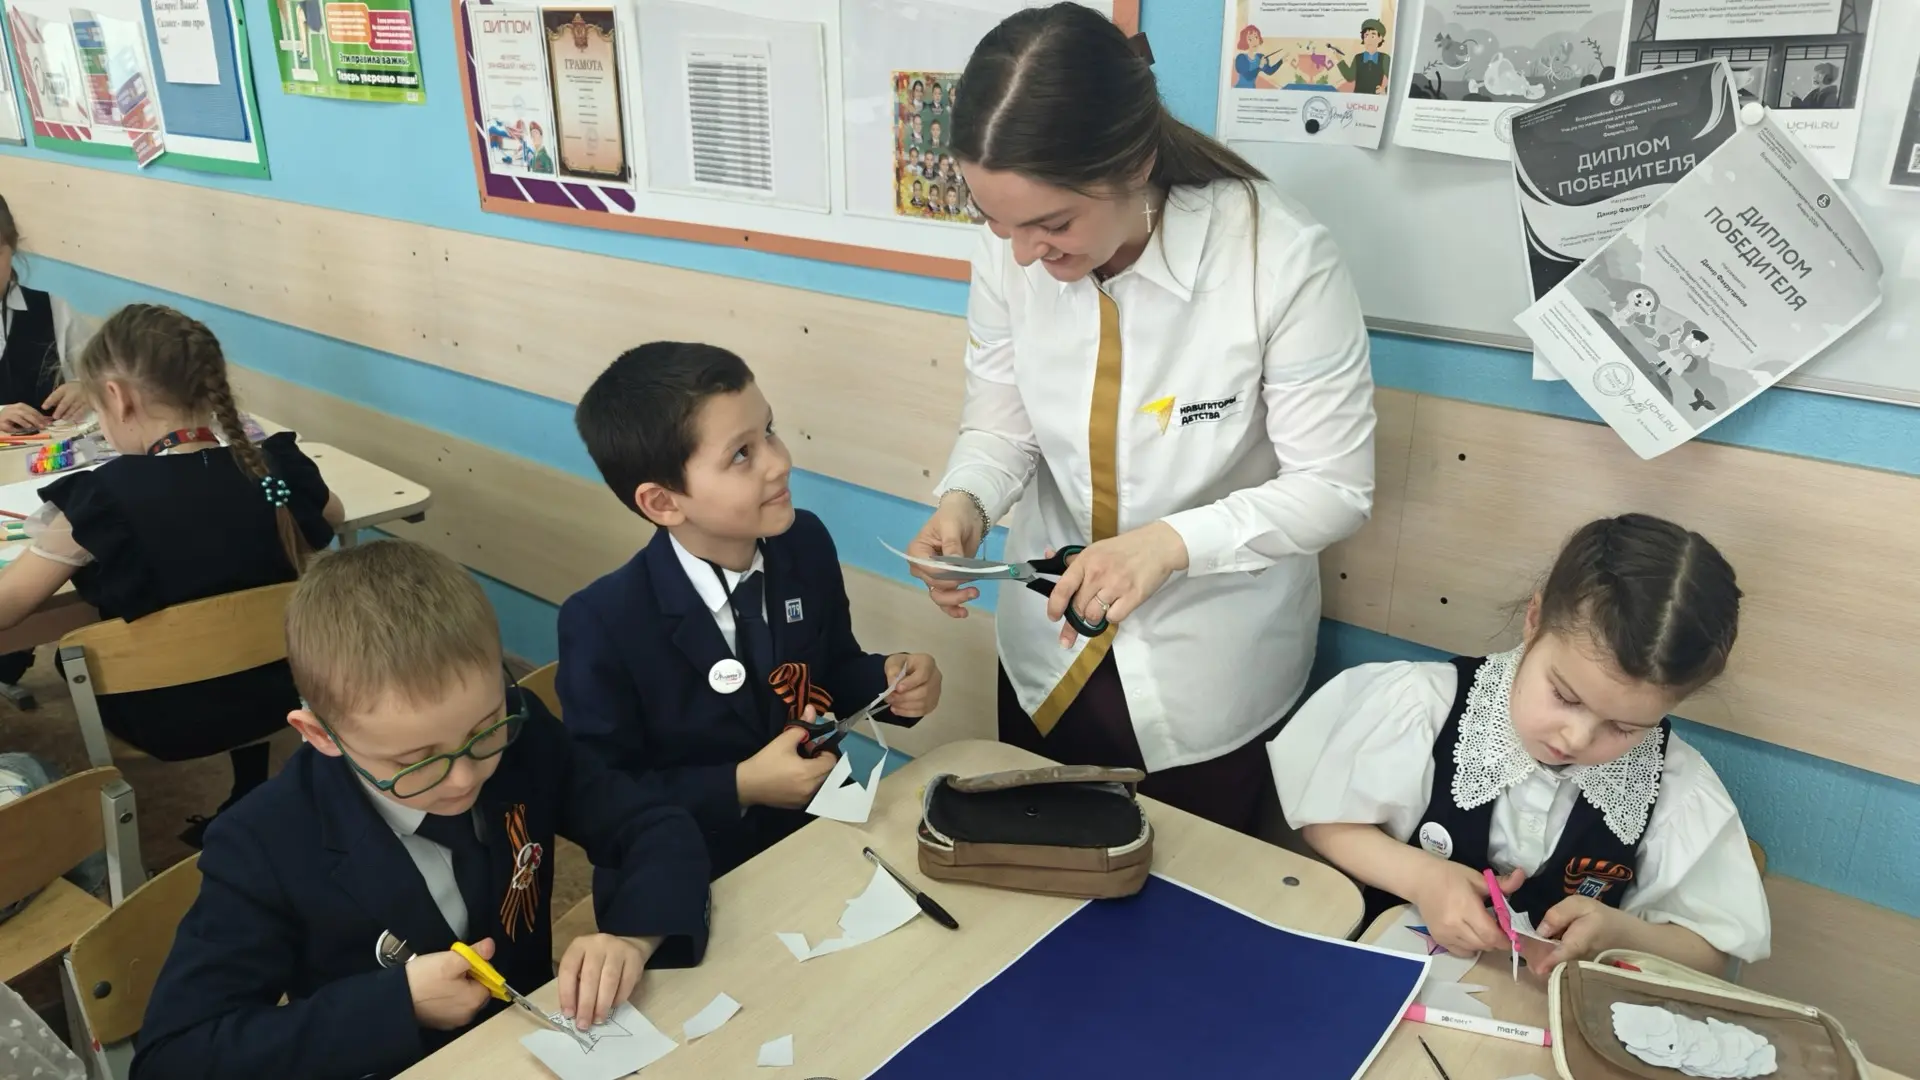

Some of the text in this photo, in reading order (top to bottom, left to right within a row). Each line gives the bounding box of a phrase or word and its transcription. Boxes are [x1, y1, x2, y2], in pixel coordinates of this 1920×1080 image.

[483, 20, 533, 34] ДИПЛОМ
[351, 55, 380, 65] правила
[564, 58, 604, 71] ГРАМОТА
[337, 70, 418, 84] Теперь уверенно пиши!
[1577, 136, 1670, 173] ДИПЛОМ
[1558, 153, 1696, 196] ПОБЕДИТЕЛЯ
[1736, 206, 1812, 279] ДИПЛОМ
[1704, 206, 1807, 311] ПОБЕДИТЕЛЯ
[1180, 396, 1236, 414] НАВИГАТОРЫ
[1181, 411, 1220, 425] ДЕТСТВА
[1581, 881, 1601, 896] 179
[1497, 1025, 1529, 1037] marker
